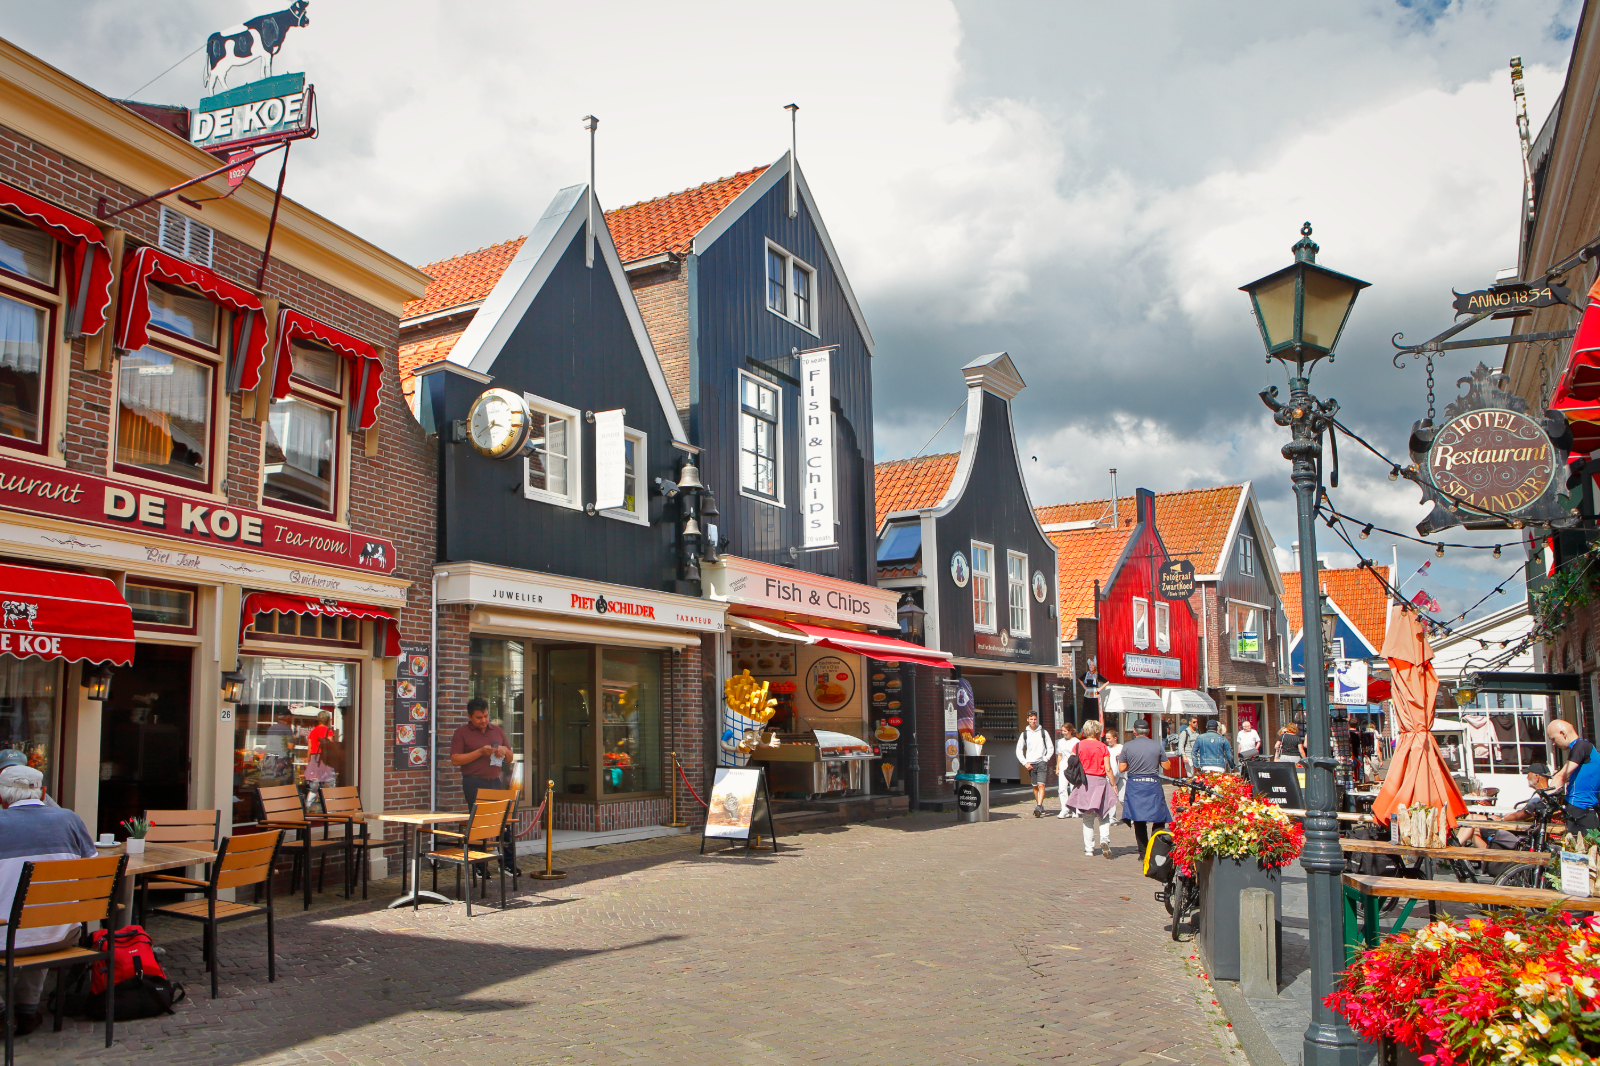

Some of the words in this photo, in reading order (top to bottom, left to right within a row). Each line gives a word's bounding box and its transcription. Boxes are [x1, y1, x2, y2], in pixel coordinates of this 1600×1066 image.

[194, 108, 234, 142] DE
[243, 93, 303, 133] KOE
[1450, 411, 1519, 437] HOTEL
[1434, 443, 1547, 471] Restaurant
[1442, 476, 1546, 513] SPAANDER
[103, 486, 166, 527] DE
[181, 502, 263, 545] KOE
[274, 525, 348, 554] Tea-room
[493, 589, 543, 604] JUWELIER
[571, 593, 596, 610] PIET
[607, 602, 656, 620] SCHILDER
[765, 577, 802, 602] Fish
[809, 590, 821, 606] &
[827, 590, 871, 615] Chips
[676, 613, 712, 625] TAXATEUR
[19, 634, 63, 655] KOE
[221, 710, 231, 719] 26
[1258, 771, 1271, 779] FREE
